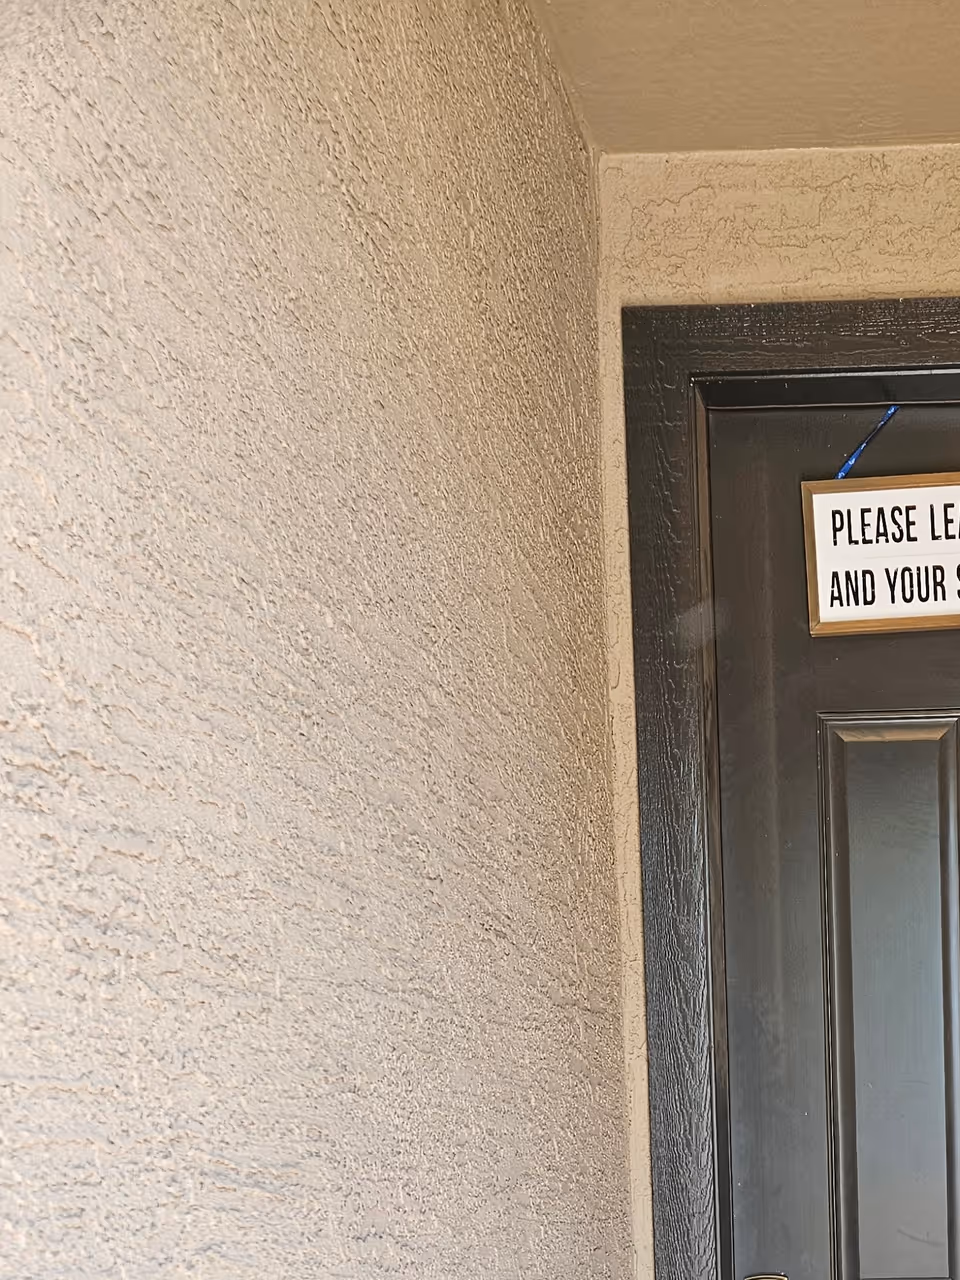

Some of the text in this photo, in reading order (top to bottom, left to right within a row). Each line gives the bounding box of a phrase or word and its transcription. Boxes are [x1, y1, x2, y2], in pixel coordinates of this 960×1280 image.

[832, 506, 918, 547] PLEASE
[829, 570, 876, 608] AND
[885, 565, 947, 605] YOUR
